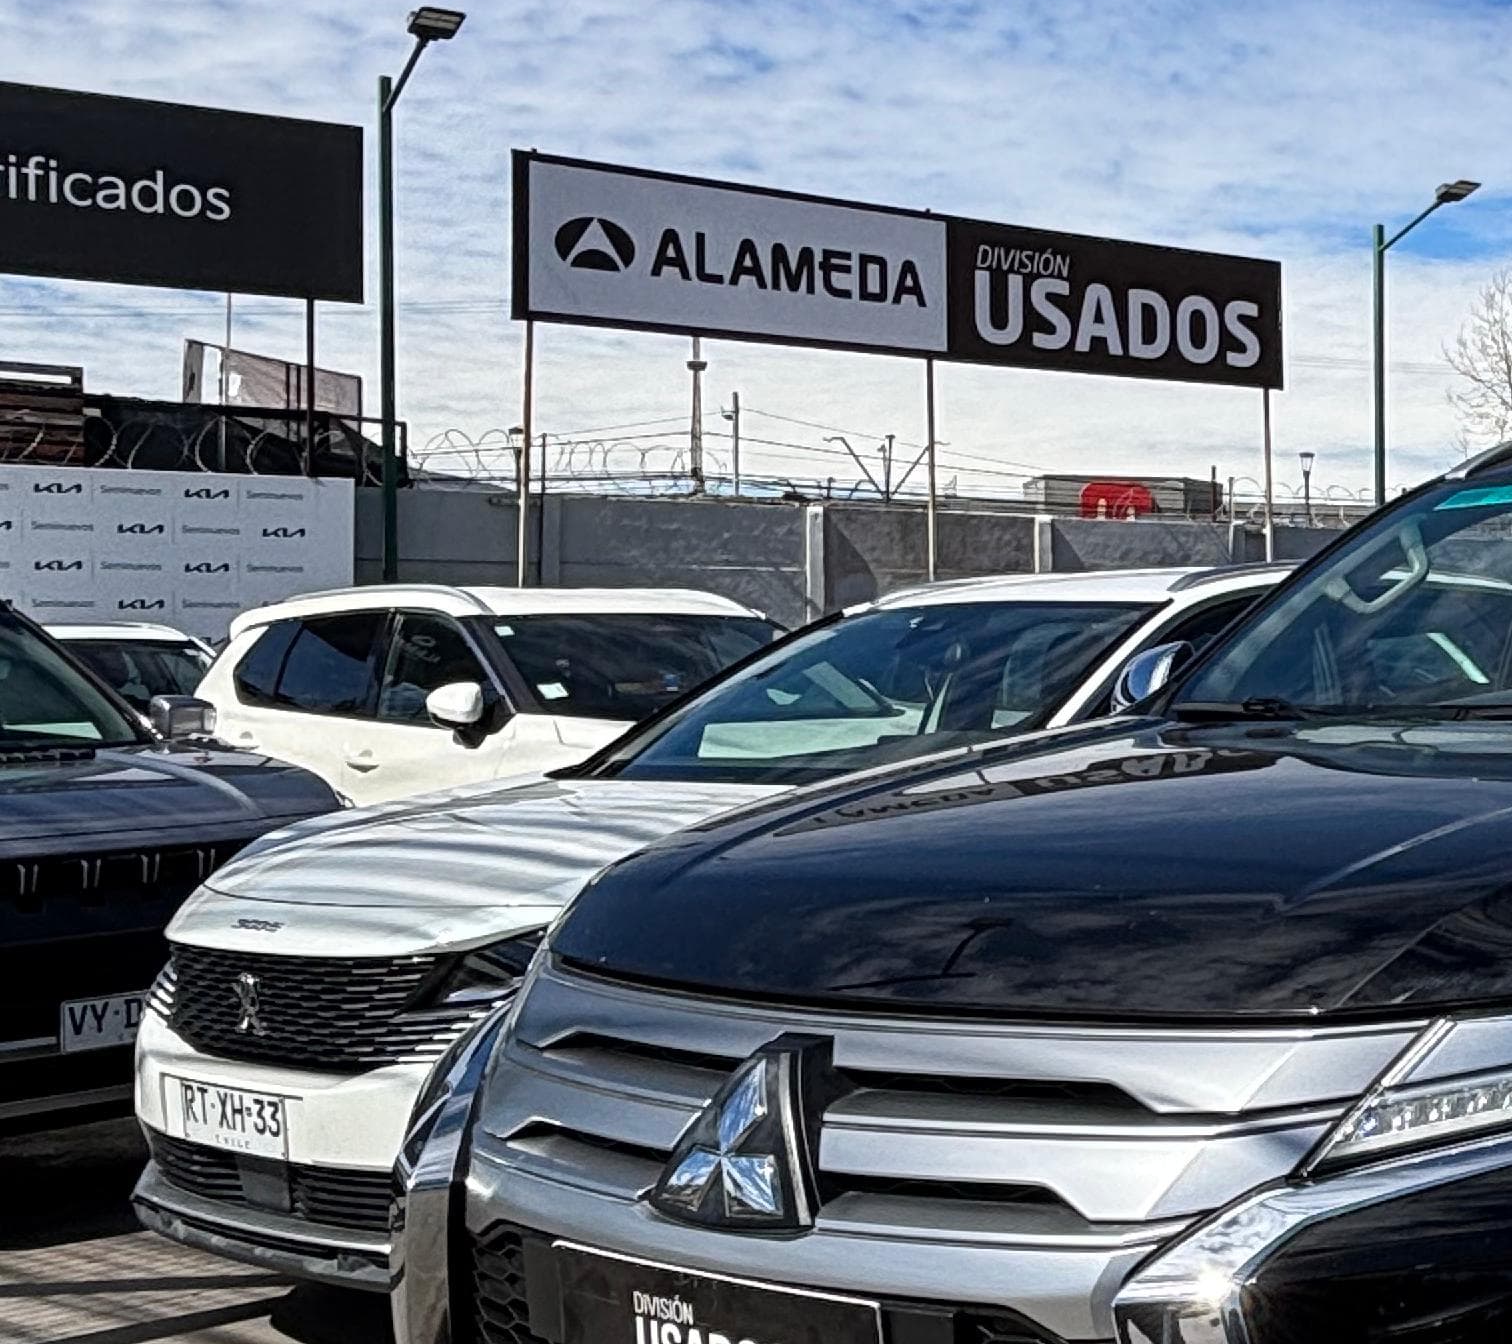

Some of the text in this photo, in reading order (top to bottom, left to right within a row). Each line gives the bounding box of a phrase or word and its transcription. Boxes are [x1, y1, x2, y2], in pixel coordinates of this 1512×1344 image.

[0, 154, 231, 220] ificados
[651, 228, 927, 307] ALAMEDA
[976, 244, 1070, 278] DIVISIÓN
[974, 269, 1261, 368] USADOS
[633, 1291, 694, 1325] DIVISIÓN
